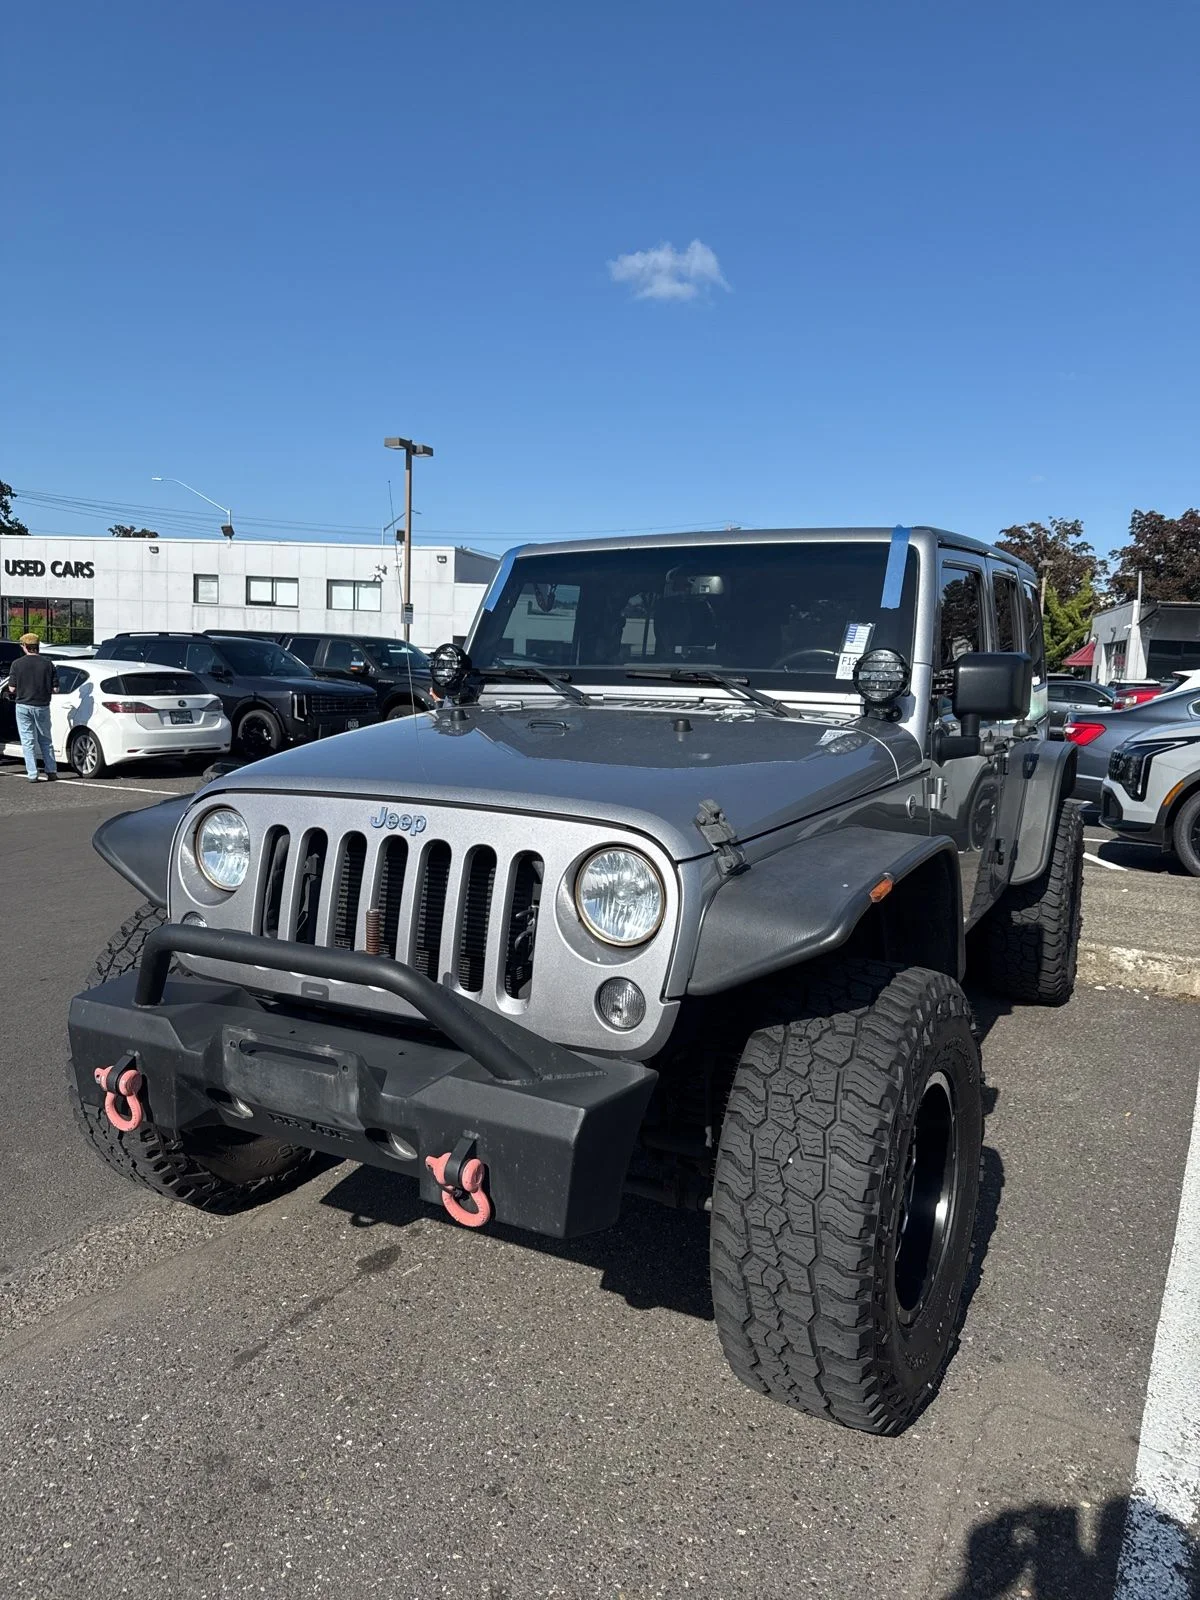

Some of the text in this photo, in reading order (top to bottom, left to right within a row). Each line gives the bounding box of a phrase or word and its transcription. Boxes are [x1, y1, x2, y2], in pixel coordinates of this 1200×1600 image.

[4, 559, 95, 579] USED CARS
[370, 806, 427, 837] Jeep
